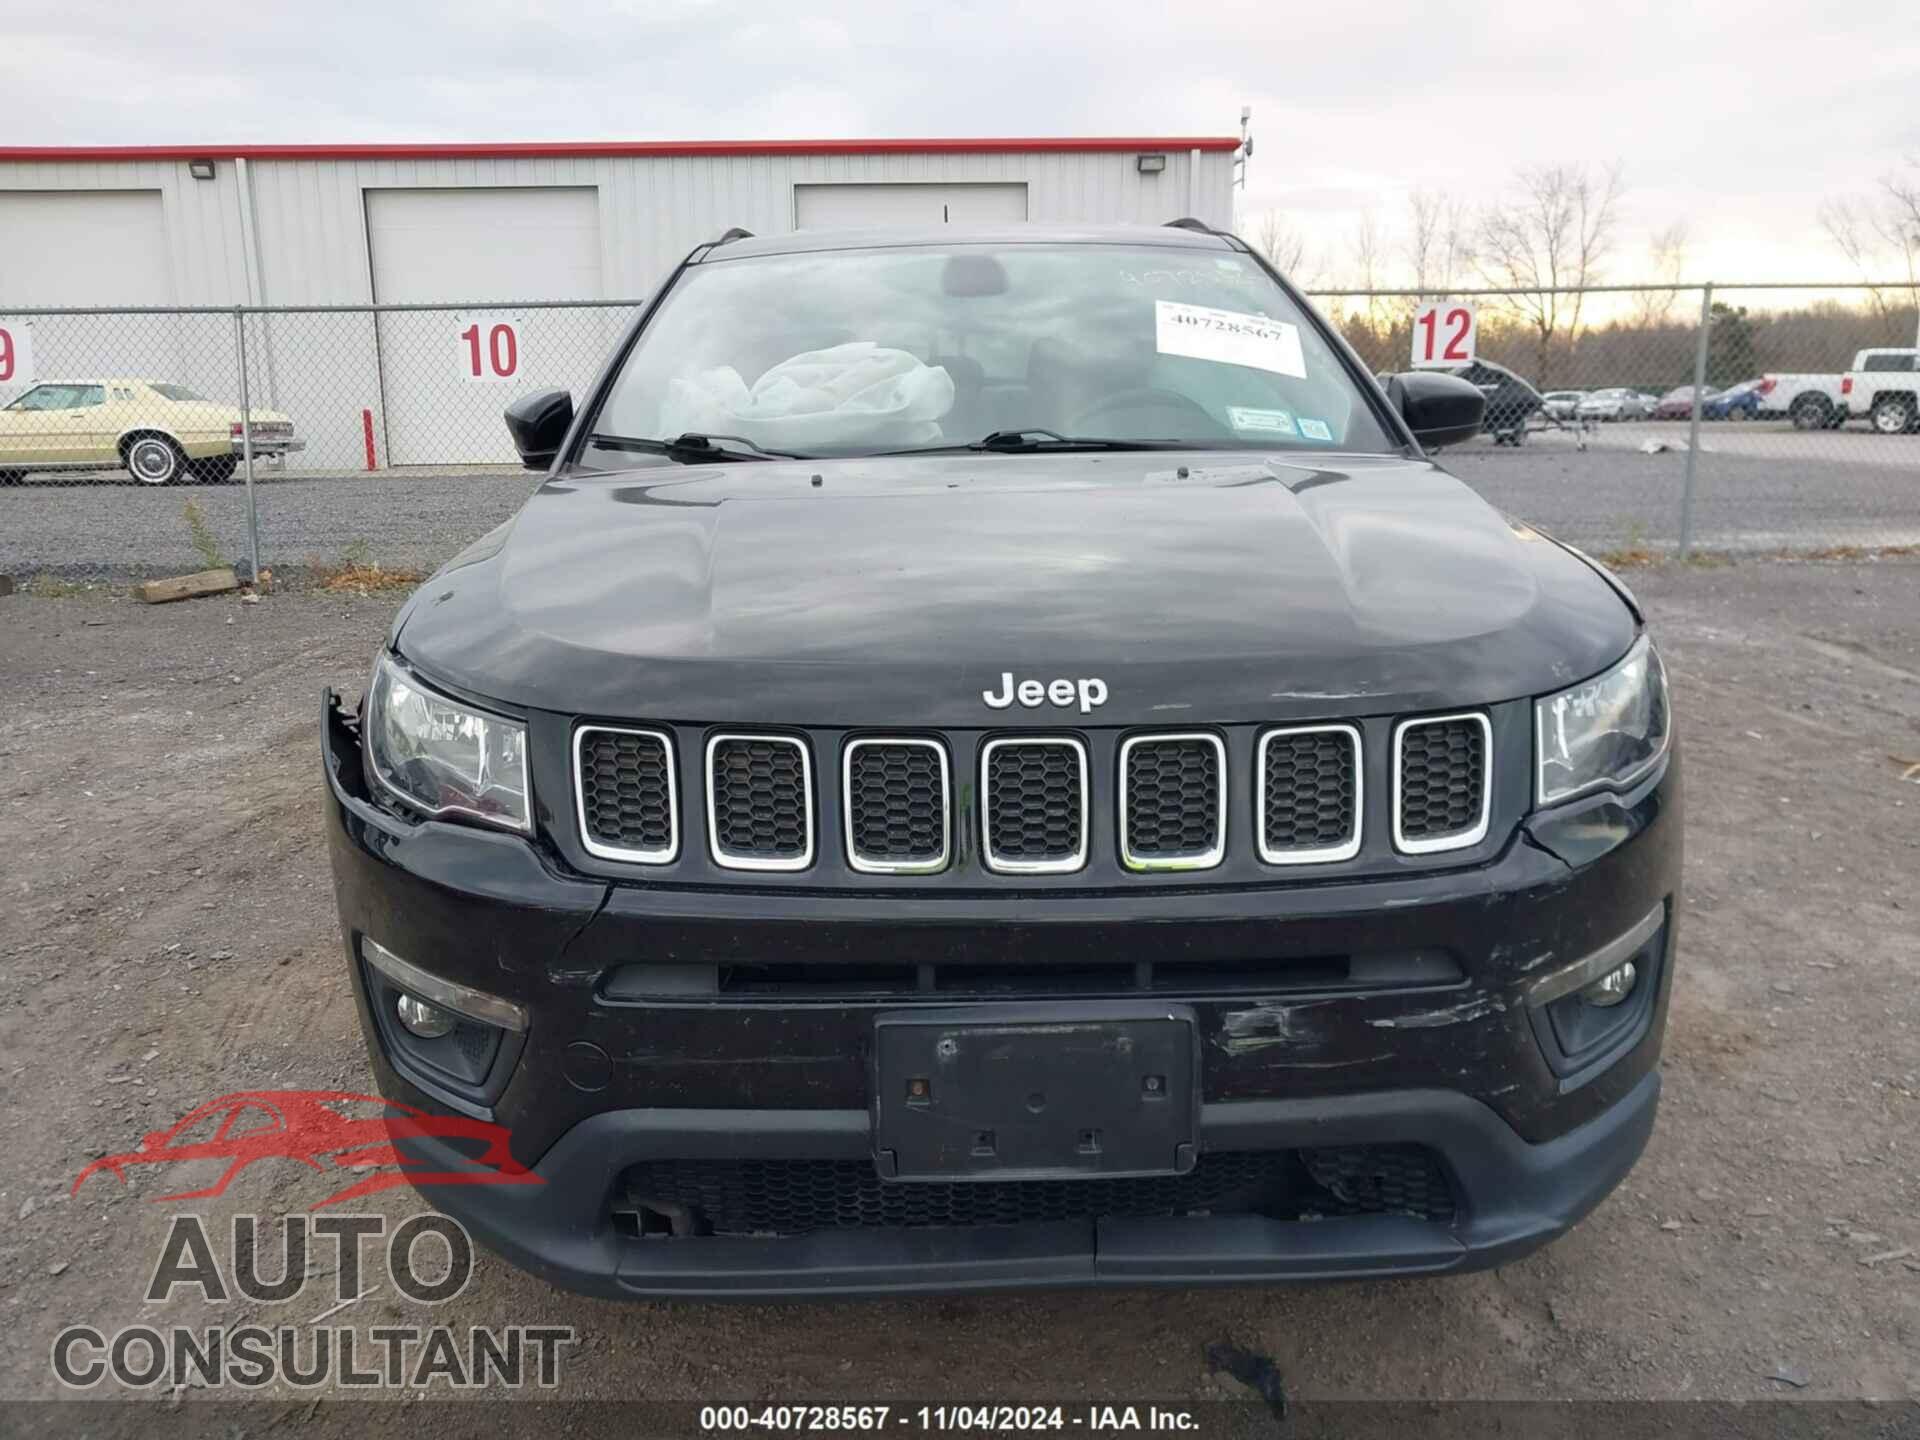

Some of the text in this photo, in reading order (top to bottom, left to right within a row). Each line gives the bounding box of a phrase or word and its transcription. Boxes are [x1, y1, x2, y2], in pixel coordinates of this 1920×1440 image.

[461, 323, 517, 377] 10
[1171, 314, 1281, 342] 40728567
[1418, 308, 1472, 360] 12
[982, 672, 1108, 712] Jeep
